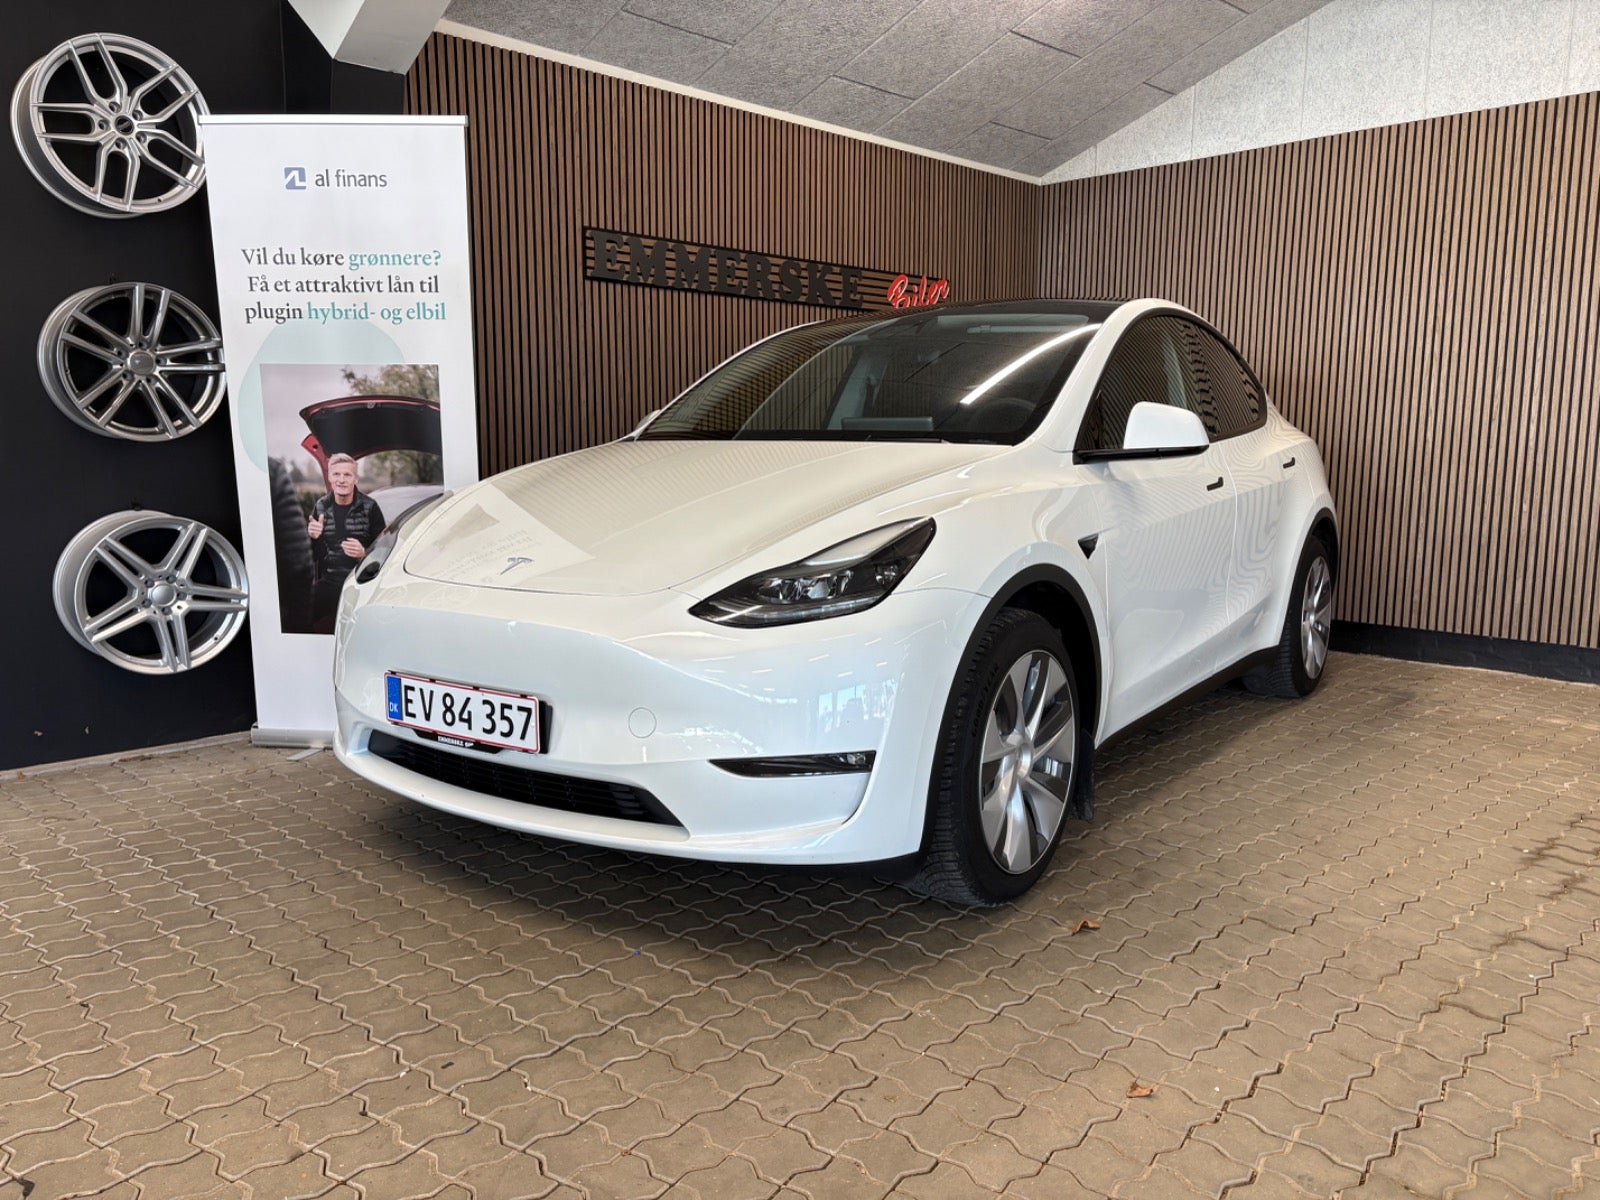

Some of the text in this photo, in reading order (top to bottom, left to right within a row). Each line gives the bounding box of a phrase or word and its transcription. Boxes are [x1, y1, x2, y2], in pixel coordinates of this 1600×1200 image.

[315, 169, 387, 187] al finans
[241, 248, 441, 270] Vil du køre grønnere?
[589, 229, 950, 310] EMMERSKE Biler
[248, 275, 439, 293] Få et attraktivt lån til
[245, 302, 446, 324] plugin hybrid- og elbil
[389, 702, 399, 713] DK
[403, 684, 532, 741] EV 84 357
